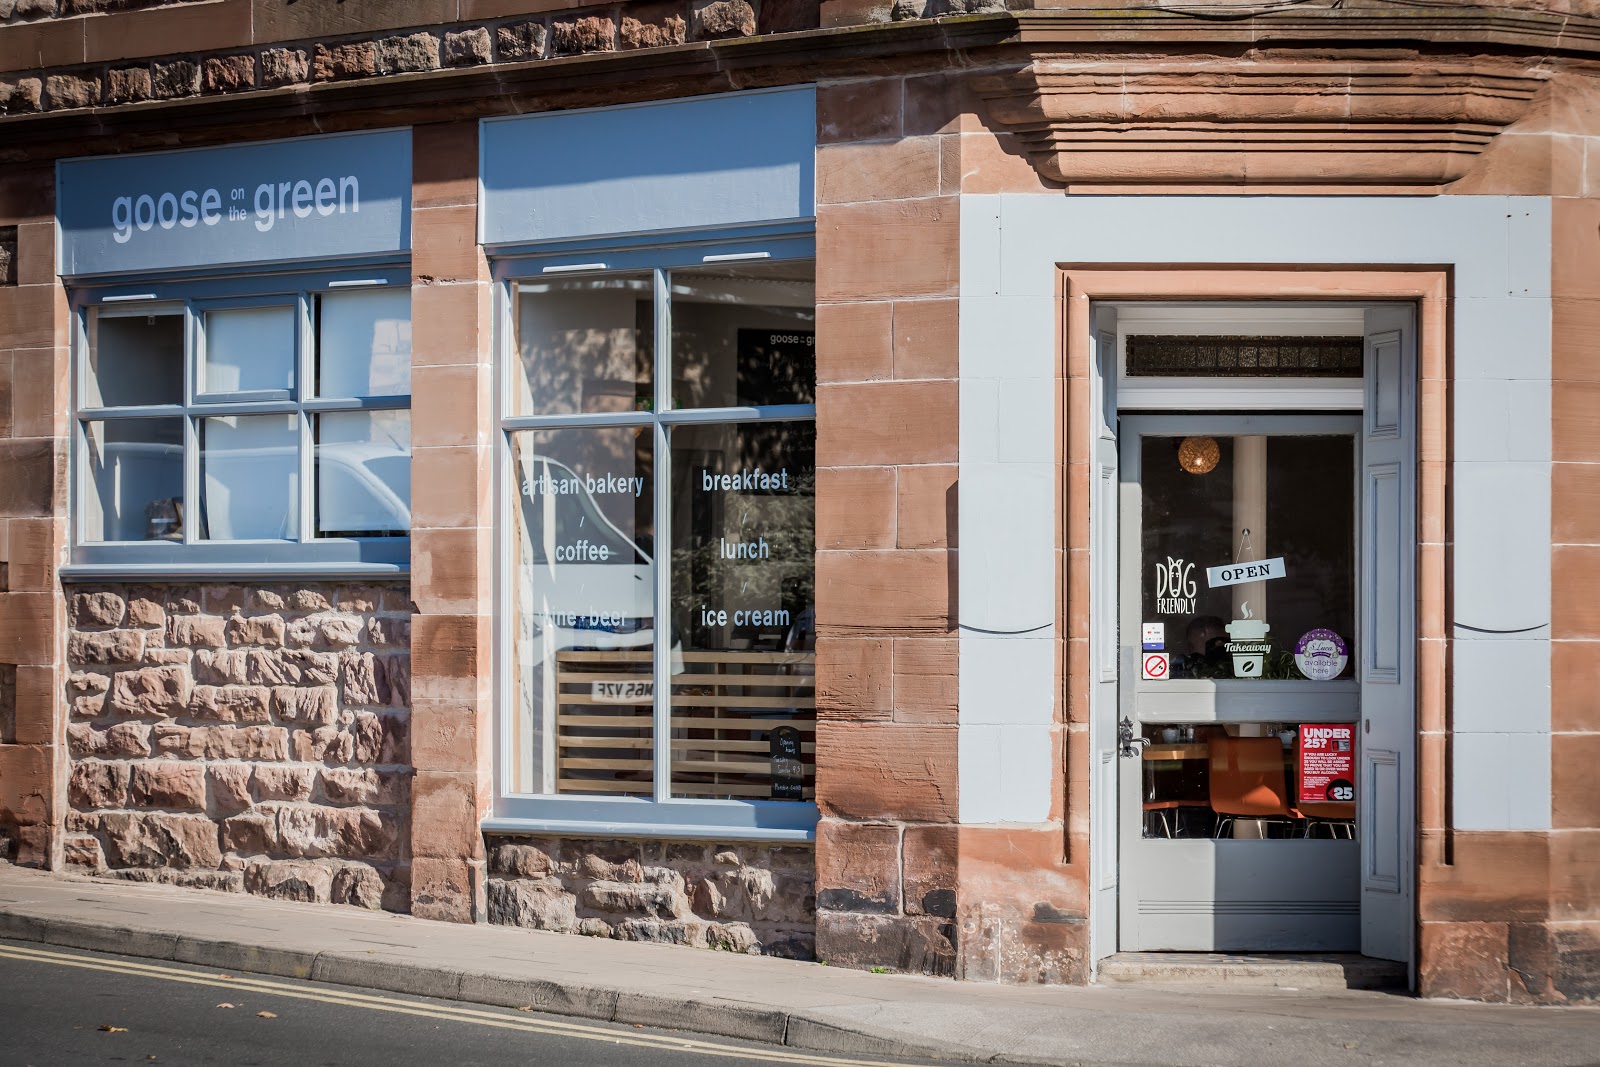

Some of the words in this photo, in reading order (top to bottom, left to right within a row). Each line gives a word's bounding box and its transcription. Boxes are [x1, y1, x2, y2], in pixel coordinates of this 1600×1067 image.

[230, 186, 245, 201] on
[253, 175, 359, 232] green
[112, 188, 222, 244] goose
[228, 205, 247, 222] the
[770, 334, 799, 345] goose
[521, 474, 579, 496] artisan
[586, 472, 644, 498] bakery
[702, 467, 788, 491] breakfast
[555, 539, 609, 562] coffee
[720, 536, 769, 559] lunch
[1155, 556, 1197, 599] DOG
[1221, 563, 1271, 582] OPEN
[589, 605, 628, 627] beer
[701, 604, 728, 627] ice
[733, 609, 790, 627] cream
[1157, 598, 1196, 614] FRIENDLY
[1224, 642, 1272, 654] Takeaway
[1303, 728, 1351, 739] UNDER
[1303, 738, 1328, 748] 25?
[1333, 786, 1353, 800] 25
